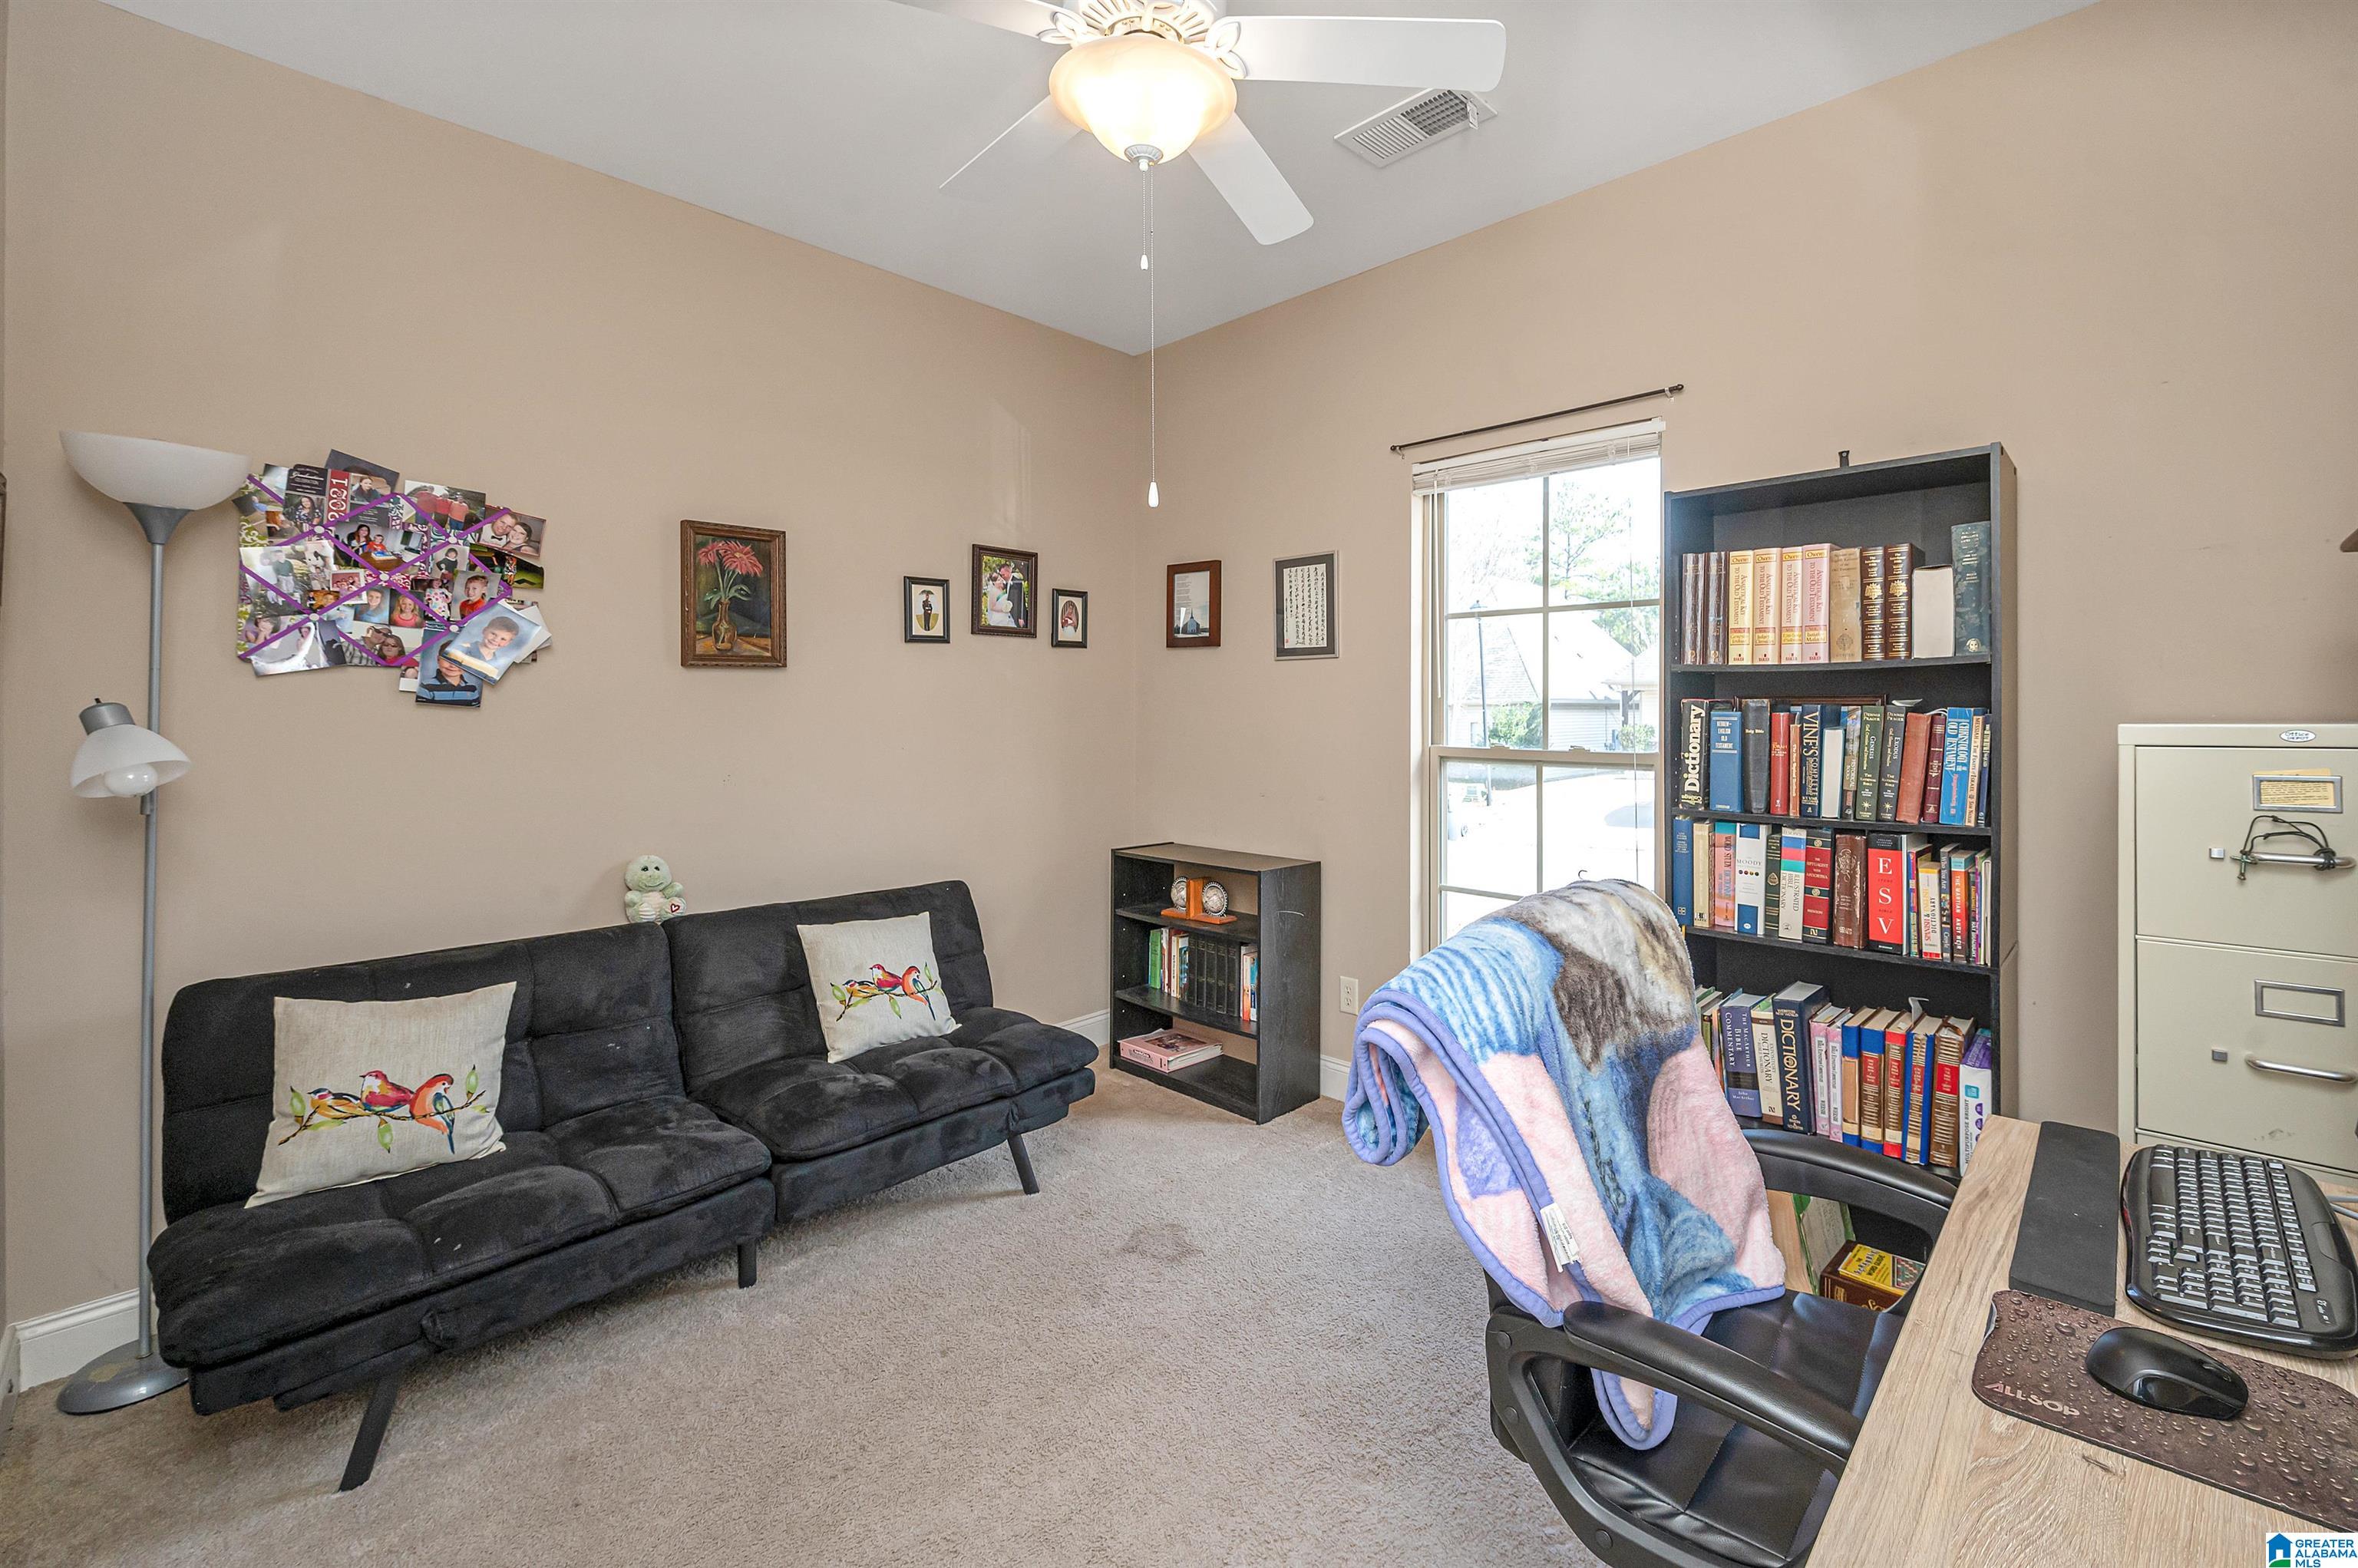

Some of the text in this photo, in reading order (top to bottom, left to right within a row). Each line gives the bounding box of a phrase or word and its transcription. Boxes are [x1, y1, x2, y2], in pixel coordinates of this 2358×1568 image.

[1683, 704, 1705, 792] Dictionary
[1803, 711, 1818, 757] VINE'S
[1945, 722, 1958, 771] OLD TESTAMENT
[1957, 722, 1970, 763] CHRISTOLOGY
[1923, 919, 1931, 941] SPANISH
[1725, 1012, 1735, 1067] COMMENTARY
[1761, 1032, 1772, 1084] DICTIONARY
[1780, 1019, 1800, 1111] DICTIONARY
[1984, 1382, 2080, 1416] ALLSOP
